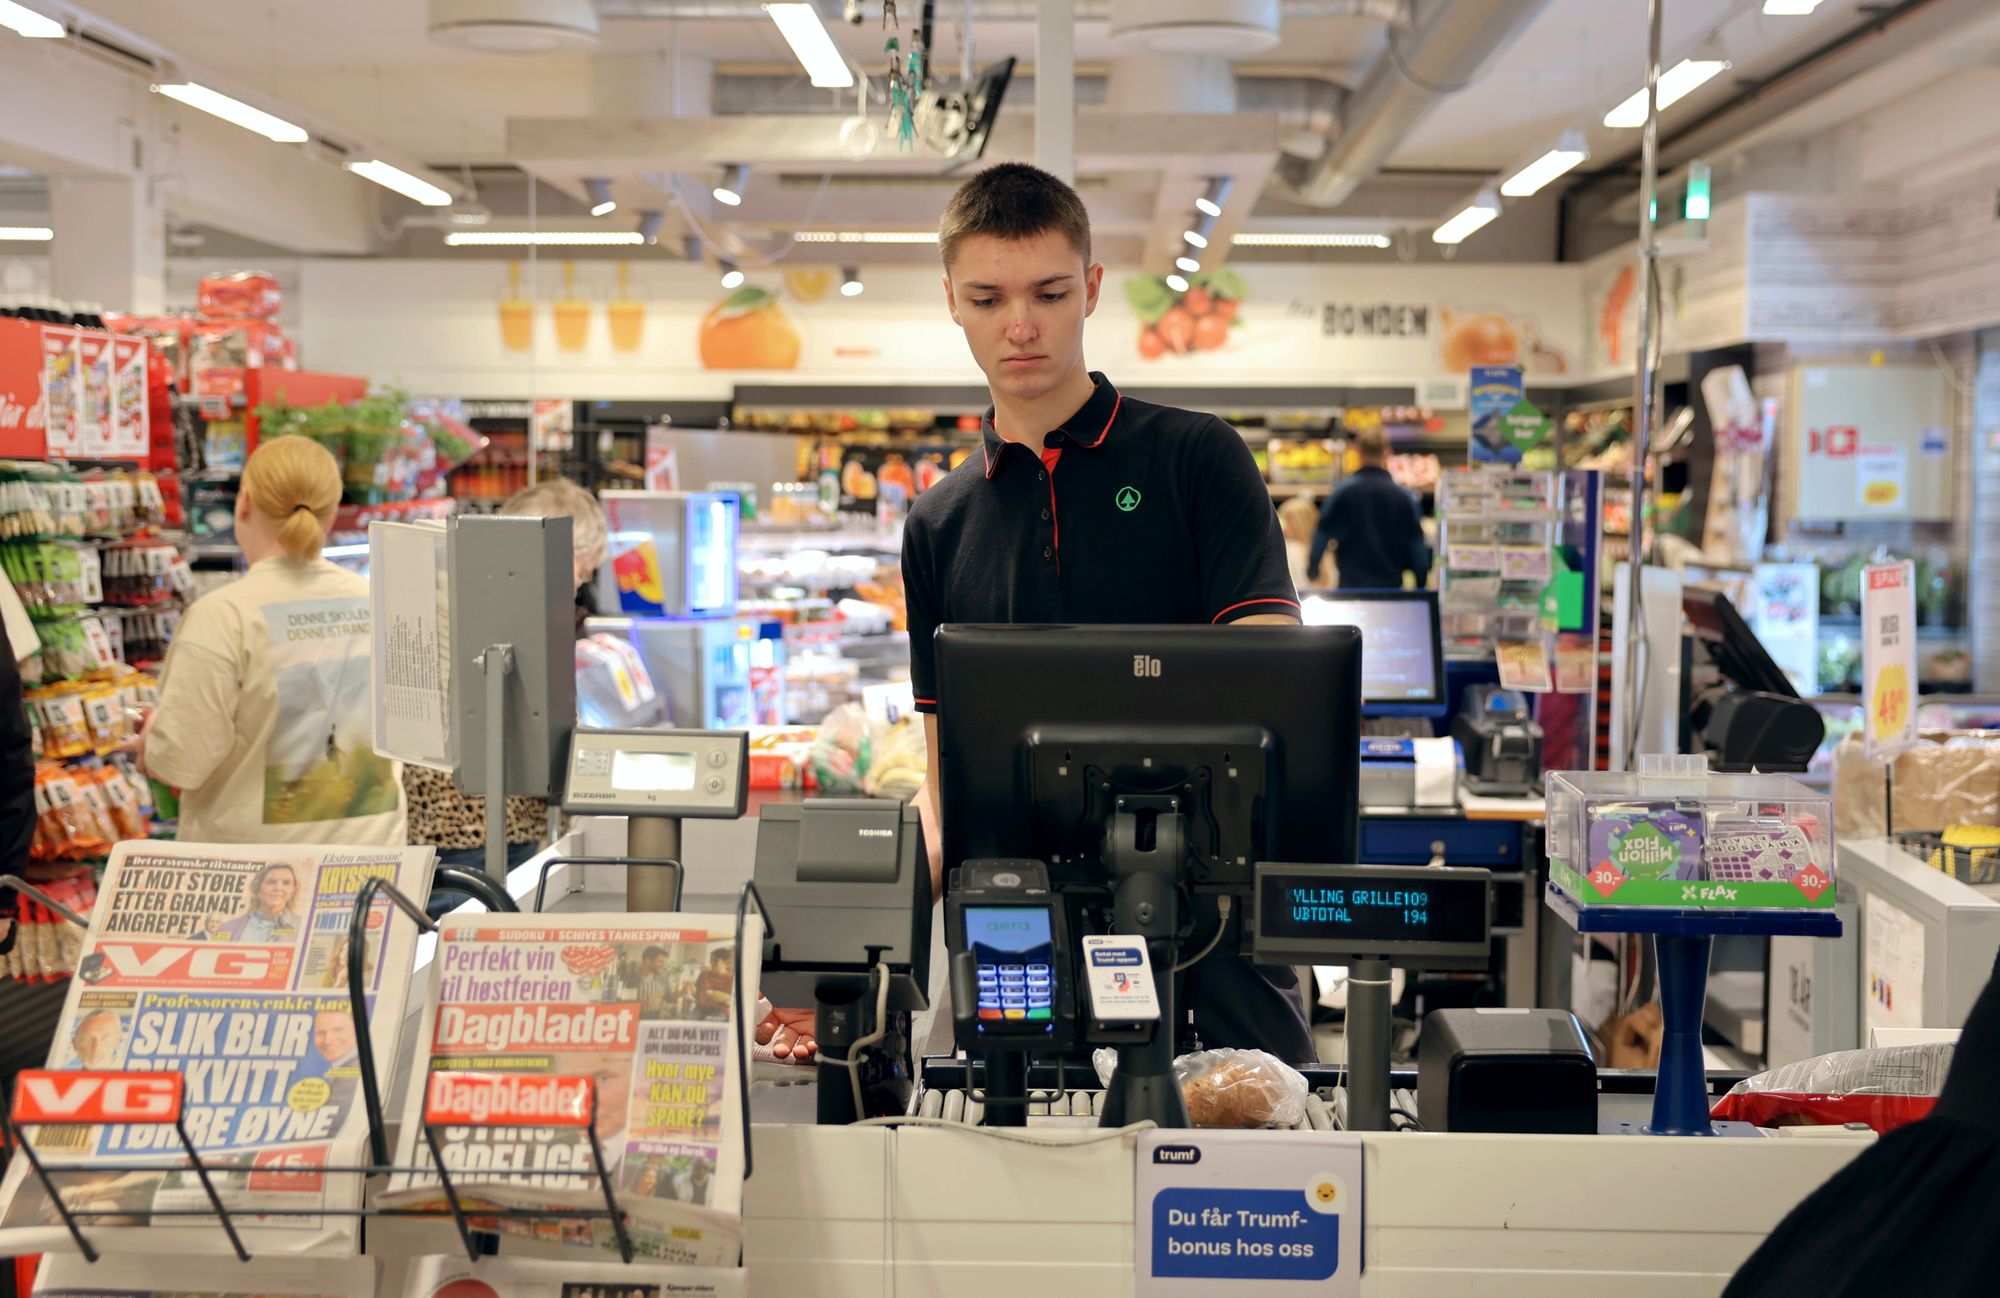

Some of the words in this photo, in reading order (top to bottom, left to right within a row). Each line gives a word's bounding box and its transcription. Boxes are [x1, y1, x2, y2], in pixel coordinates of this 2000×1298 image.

[1324, 303, 1428, 336] BONDEN
[287, 611, 328, 626] DENNE
[287, 626, 325, 641] DENNE
[573, 792, 616, 800] BIZERBA
[648, 793, 656, 802] kg
[859, 829, 893, 837] TOSHIBA
[1624, 836, 1659, 850] Flax
[1619, 846, 1672, 864] Million
[119, 869, 144, 889] UT
[145, 871, 188, 890] MOT
[187, 873, 248, 893] STØRE
[1595, 871, 1620, 885] 30,-
[1801, 874, 1826, 888] 30,-
[112, 891, 169, 912] ETTER
[169, 893, 246, 915] GRANAT-
[1700, 885, 1738, 900] FLAX
[105, 912, 201, 935] ANGREPET
[987, 921, 1030, 932] aera
[1404, 909, 1427, 924] 194
[499, 930, 545, 941] SUDOKU
[559, 930, 605, 941] SCHIVES
[608, 930, 680, 941] TANKESPINN
[101, 945, 271, 980] VG
[444, 945, 522, 971] Perfekt
[526, 946, 556, 971] vin
[440, 974, 464, 1001] til
[466, 975, 572, 1001] høstferien
[144, 994, 258, 1010] Professorens
[263, 996, 313, 1011] enkle
[131, 1011, 224, 1056] SLIK
[222, 1013, 314, 1057] BLIR
[437, 1006, 632, 1050] Dagbladet
[648, 1028, 665, 1040] ALT
[667, 1028, 680, 1040] DU
[700, 1029, 720, 1042] VITE
[644, 1042, 660, 1055] OM
[661, 1043, 721, 1057] NORGESPRIS
[183, 1059, 297, 1104] KVITT
[646, 1058, 681, 1079] Hvor
[684, 1063, 716, 1085] mye
[24, 1077, 175, 1115] VG
[430, 1077, 588, 1122] Dagbladet
[650, 1083, 683, 1103] KAN
[686, 1085, 708, 1104] DU
[231, 1104, 341, 1145] ØYNE
[646, 1106, 705, 1128] SPARE?
[1160, 1149, 1195, 1161] trumf
[1168, 1208, 1196, 1226] Du
[1201, 1207, 1232, 1227] får
[1237, 1210, 1308, 1228] Trumf-
[1168, 1236, 1231, 1255] bonus
[1237, 1238, 1273, 1256] hos
[1278, 1242, 1314, 1257] oss
